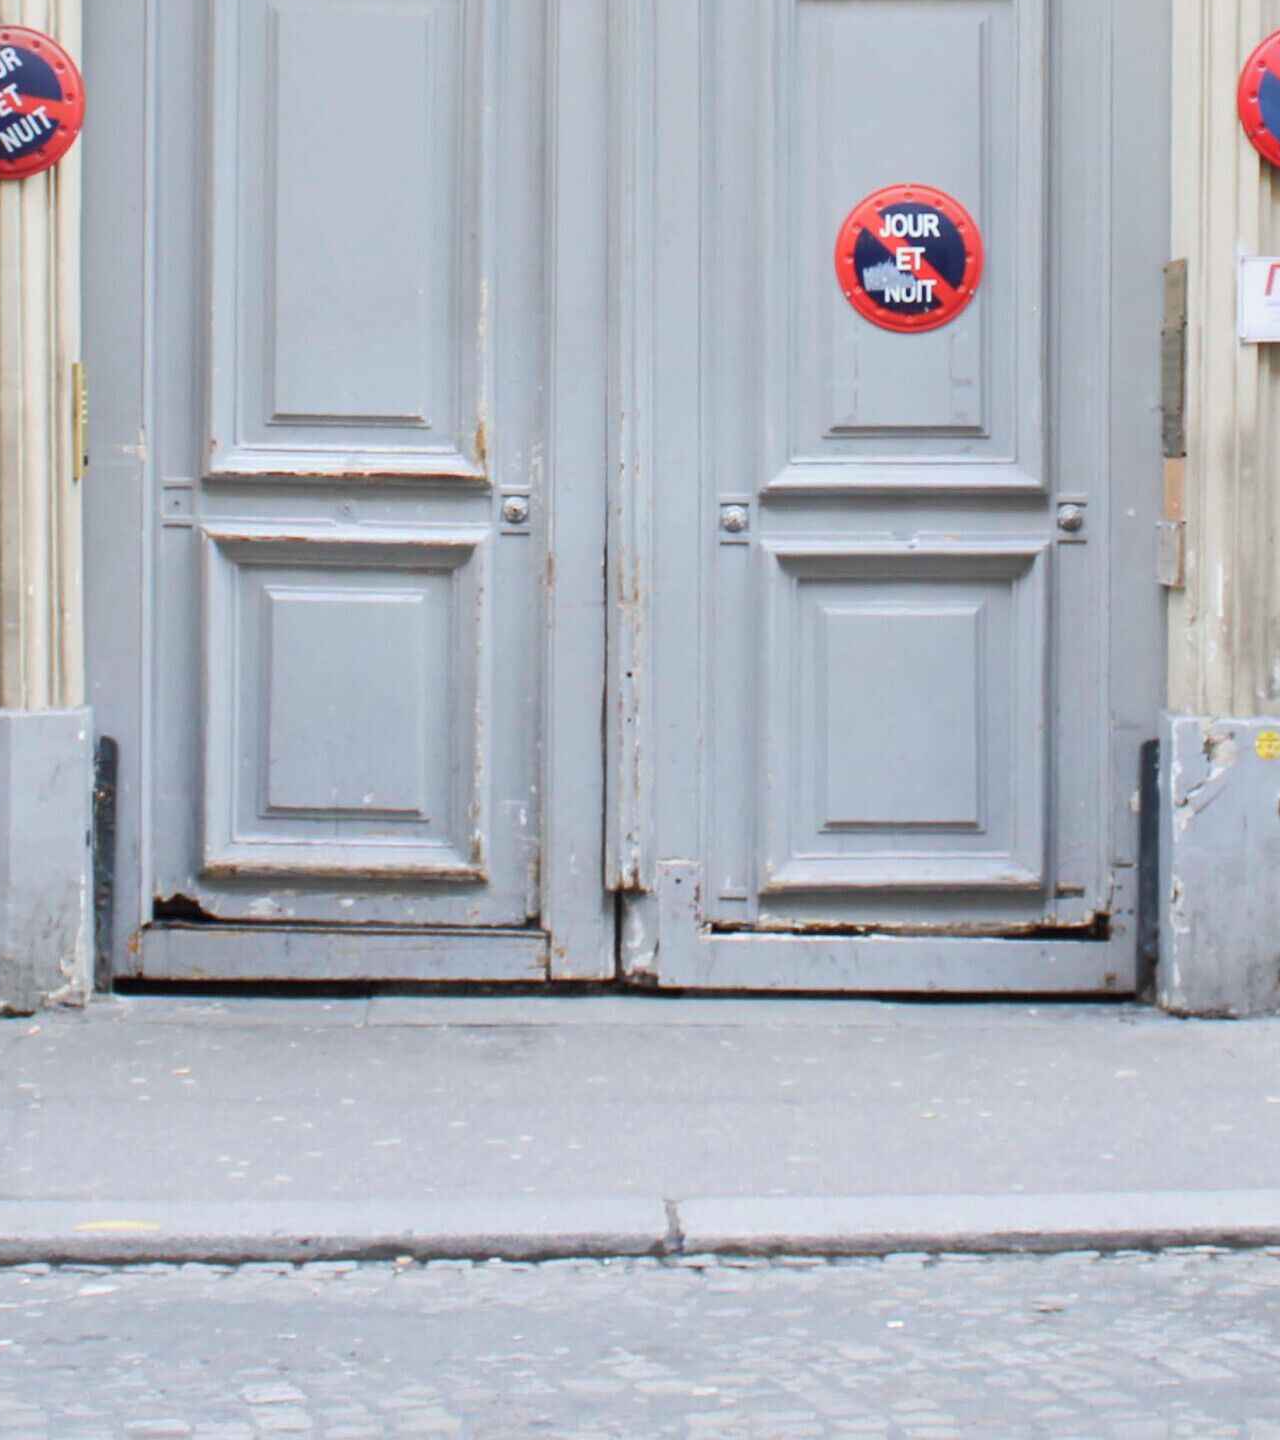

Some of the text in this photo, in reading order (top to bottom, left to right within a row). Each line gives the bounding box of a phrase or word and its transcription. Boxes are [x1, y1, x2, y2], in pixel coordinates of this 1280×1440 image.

[879, 213, 941, 238] JOUR
[895, 246, 927, 271] ET
[884, 279, 938, 303] NUIT
